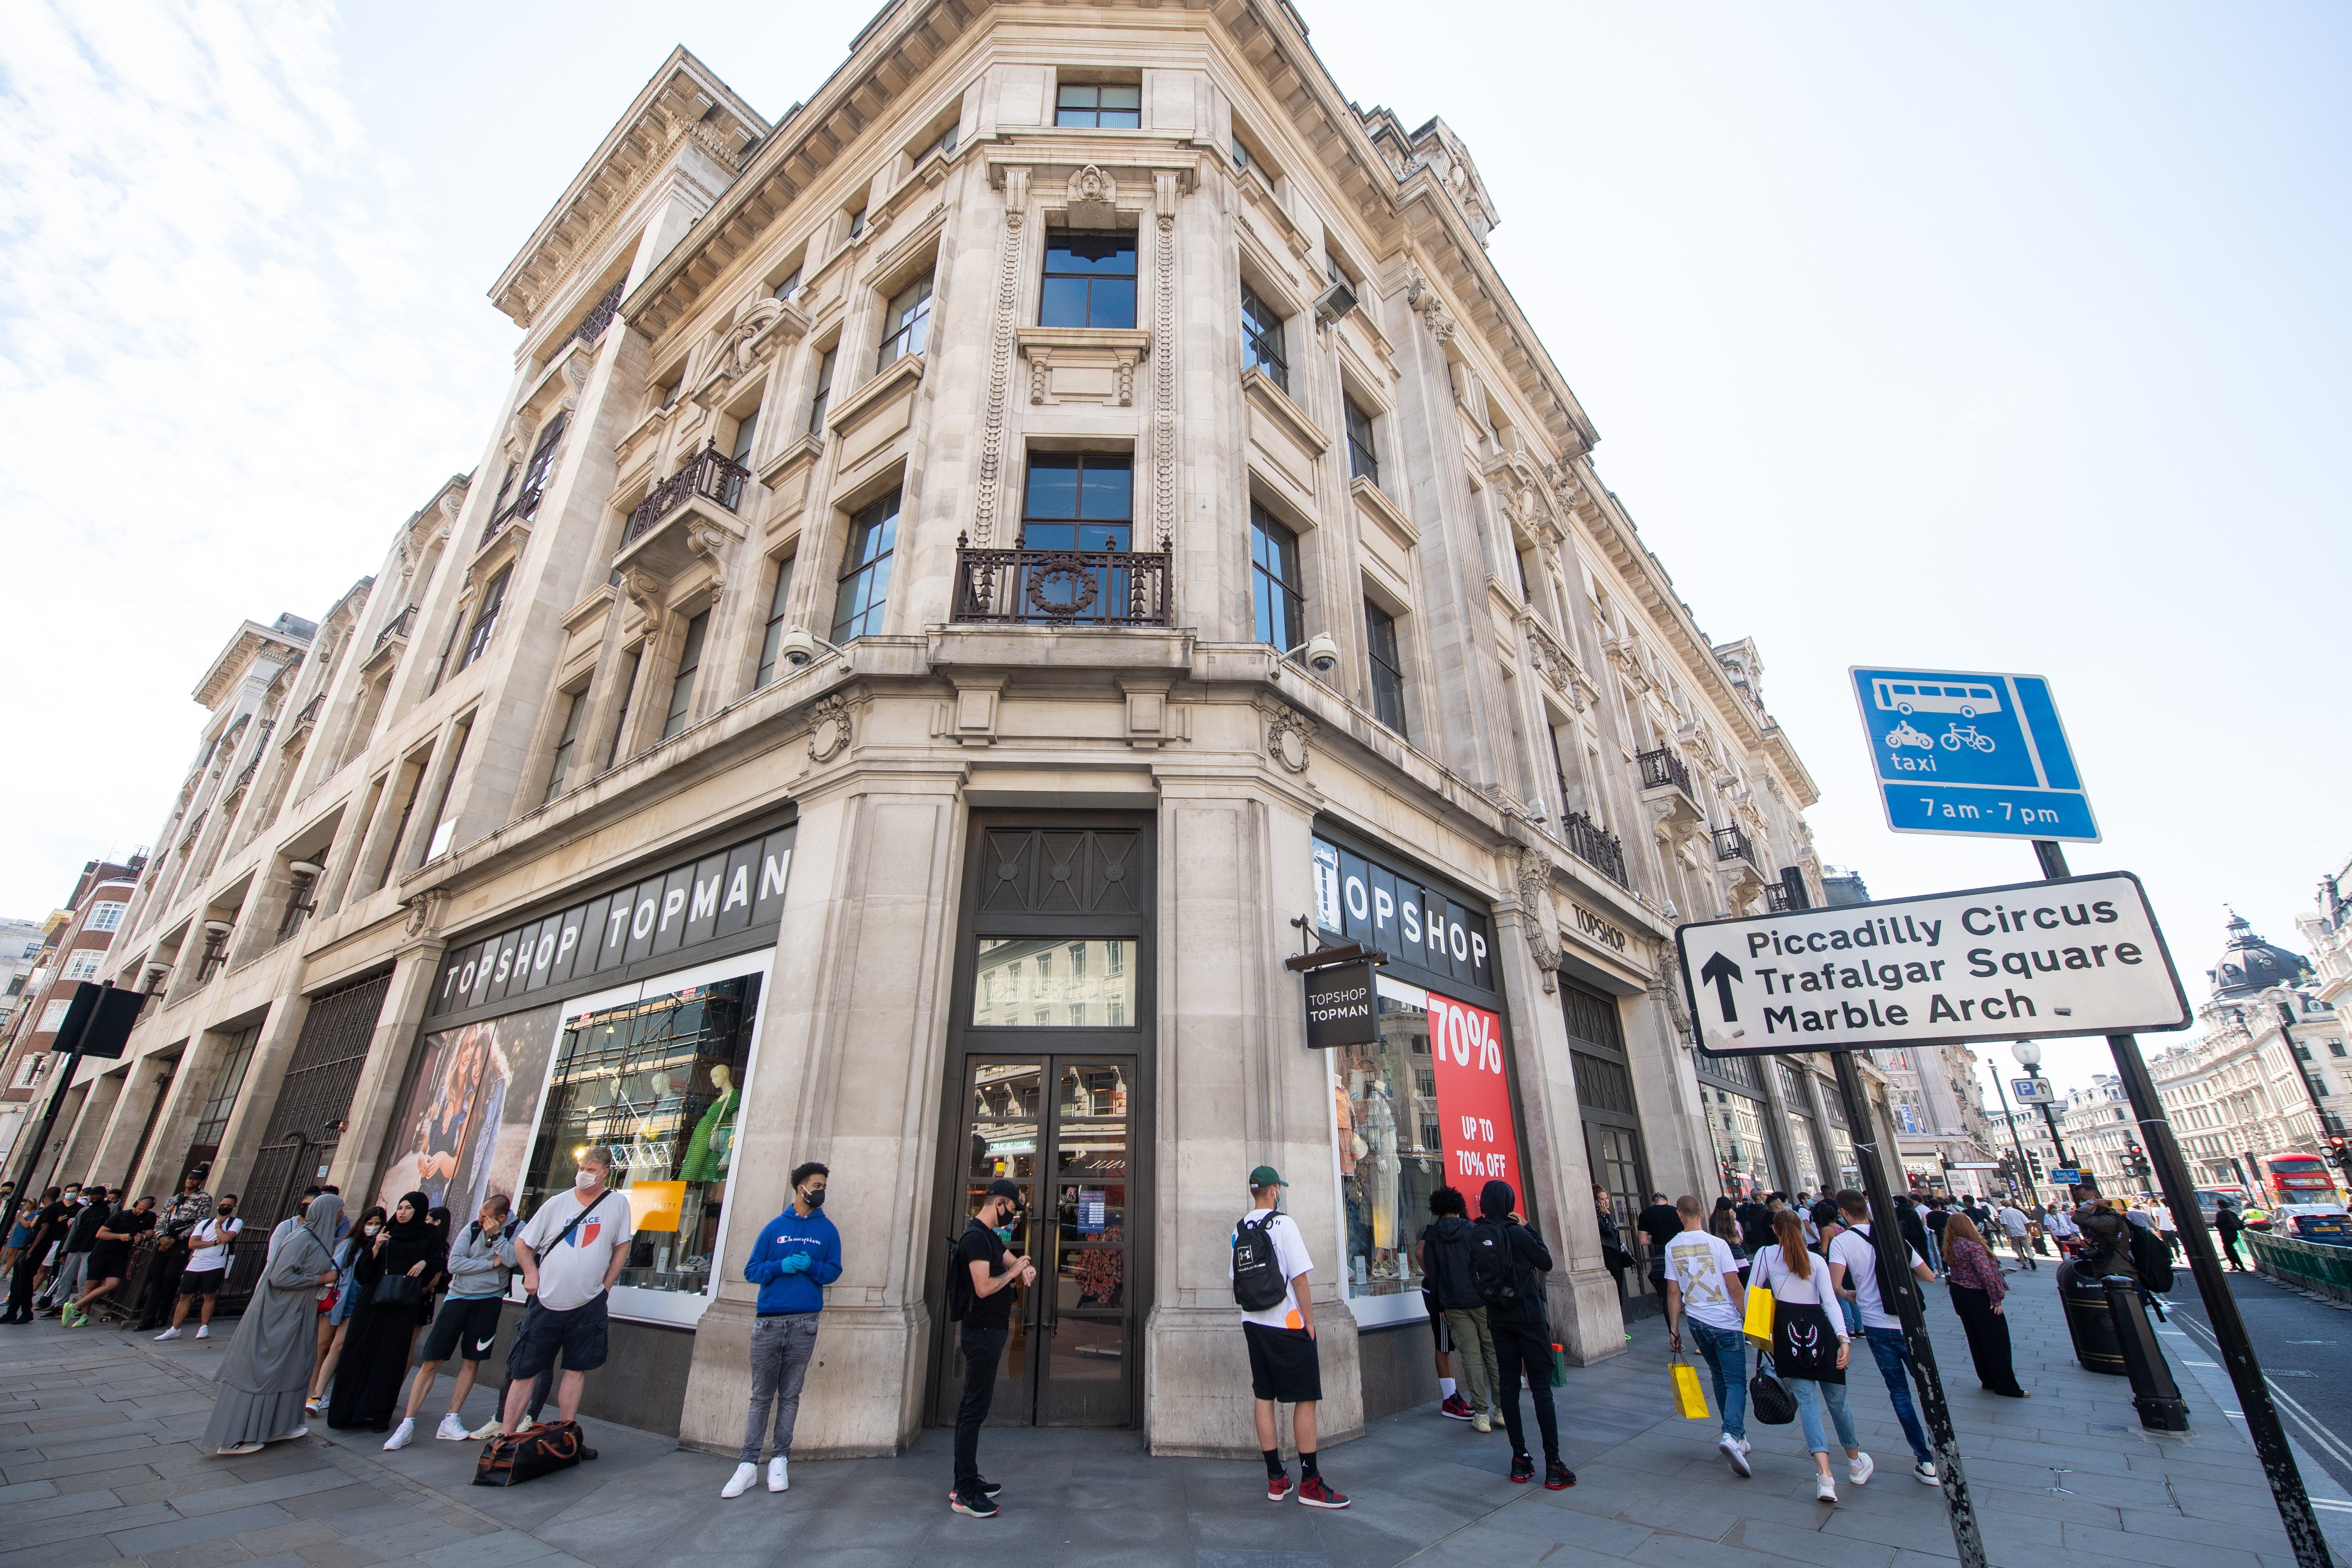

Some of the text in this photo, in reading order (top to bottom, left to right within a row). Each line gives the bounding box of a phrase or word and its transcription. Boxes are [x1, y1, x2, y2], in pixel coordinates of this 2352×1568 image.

[1891, 753, 1937, 771] taxi
[444, 849, 791, 998] TOPSHOP TOPMAN
[1572, 903, 1626, 953] TOPSHOP
[1747, 902, 2118, 958] Piccadilly Circus
[1755, 943, 2143, 995] Trafalgar Square
[1309, 988, 1367, 1006] TOPSHOP
[1310, 1004, 1368, 1022] TOPMAN
[1763, 989, 2036, 1034] Marble Arch
[1429, 997, 1501, 1075] 70%
[2019, 1083, 2030, 1094] P
[1461, 1115, 1494, 1143] UP TO
[1456, 1150, 1506, 1177] 70% OFF
[565, 1217, 600, 1225] PAACE
[777, 1235, 822, 1245] Champion
